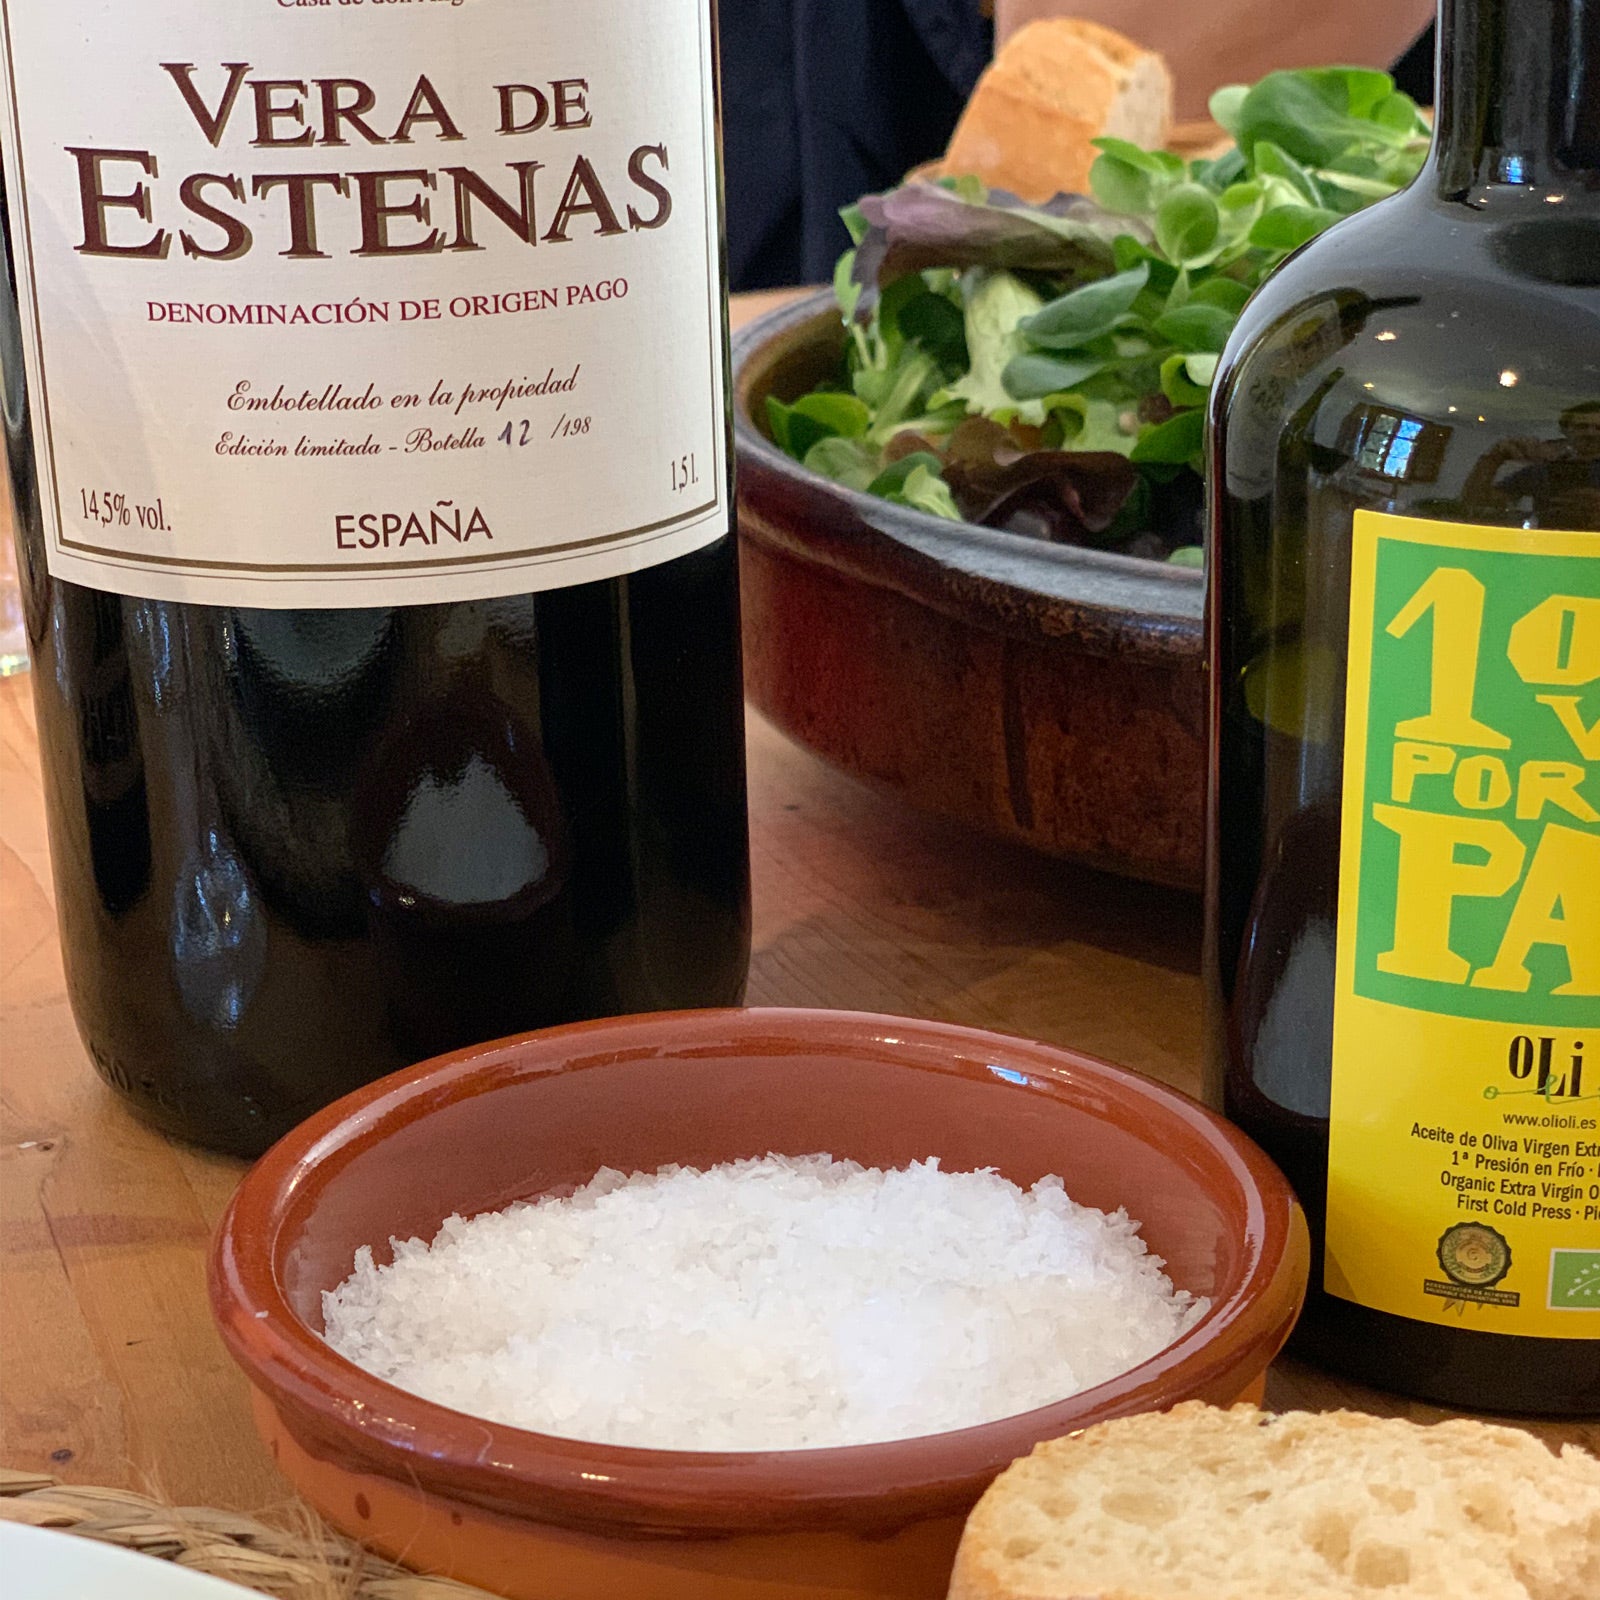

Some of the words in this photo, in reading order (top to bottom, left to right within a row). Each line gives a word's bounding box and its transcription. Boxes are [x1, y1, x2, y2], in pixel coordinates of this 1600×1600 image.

[159, 62, 465, 149] VERA
[492, 78, 593, 137] DE
[63, 142, 673, 261] ESTENAS
[147, 297, 390, 326] DENOMINACIÓN
[400, 300, 442, 322] DE
[450, 288, 560, 317] ORIGEN
[566, 277, 629, 307] PAGO
[227, 380, 383, 412] Embotellado
[390, 394, 421, 409] en
[429, 379, 454, 406] la
[455, 364, 581, 416] propiedad
[215, 432, 289, 457] Edición
[294, 433, 382, 457] limitada
[405, 427, 486, 454] Botella
[497, 418, 534, 448] 12
[551, 412, 593, 440] /198
[81, 488, 131, 528] 14,5%
[135, 497, 172, 531] vol.
[335, 500, 493, 551] ESPAÑA
[1385, 566, 1512, 750] 1
[1391, 741, 1600, 821] POR
[1411, 1122, 1455, 1144] Aceite
[1459, 1131, 1477, 1148] de
[1482, 1134, 1518, 1153] Oliva
[1523, 1138, 1570, 1159] Virgen
[1503, 1112, 1597, 1130] www.olioli.es
[1440, 1170, 1496, 1193] Organic
[1500, 1178, 1536, 1197] Extra
[1541, 1181, 1583, 1203] Virgin
[1475, 1153, 1529, 1175] Presión
[1534, 1163, 1552, 1176] en
[1557, 1161, 1585, 1178] Frío
[1457, 1193, 1489, 1213] First
[1493, 1199, 1527, 1217] Cold
[1532, 1202, 1571, 1220] Press
